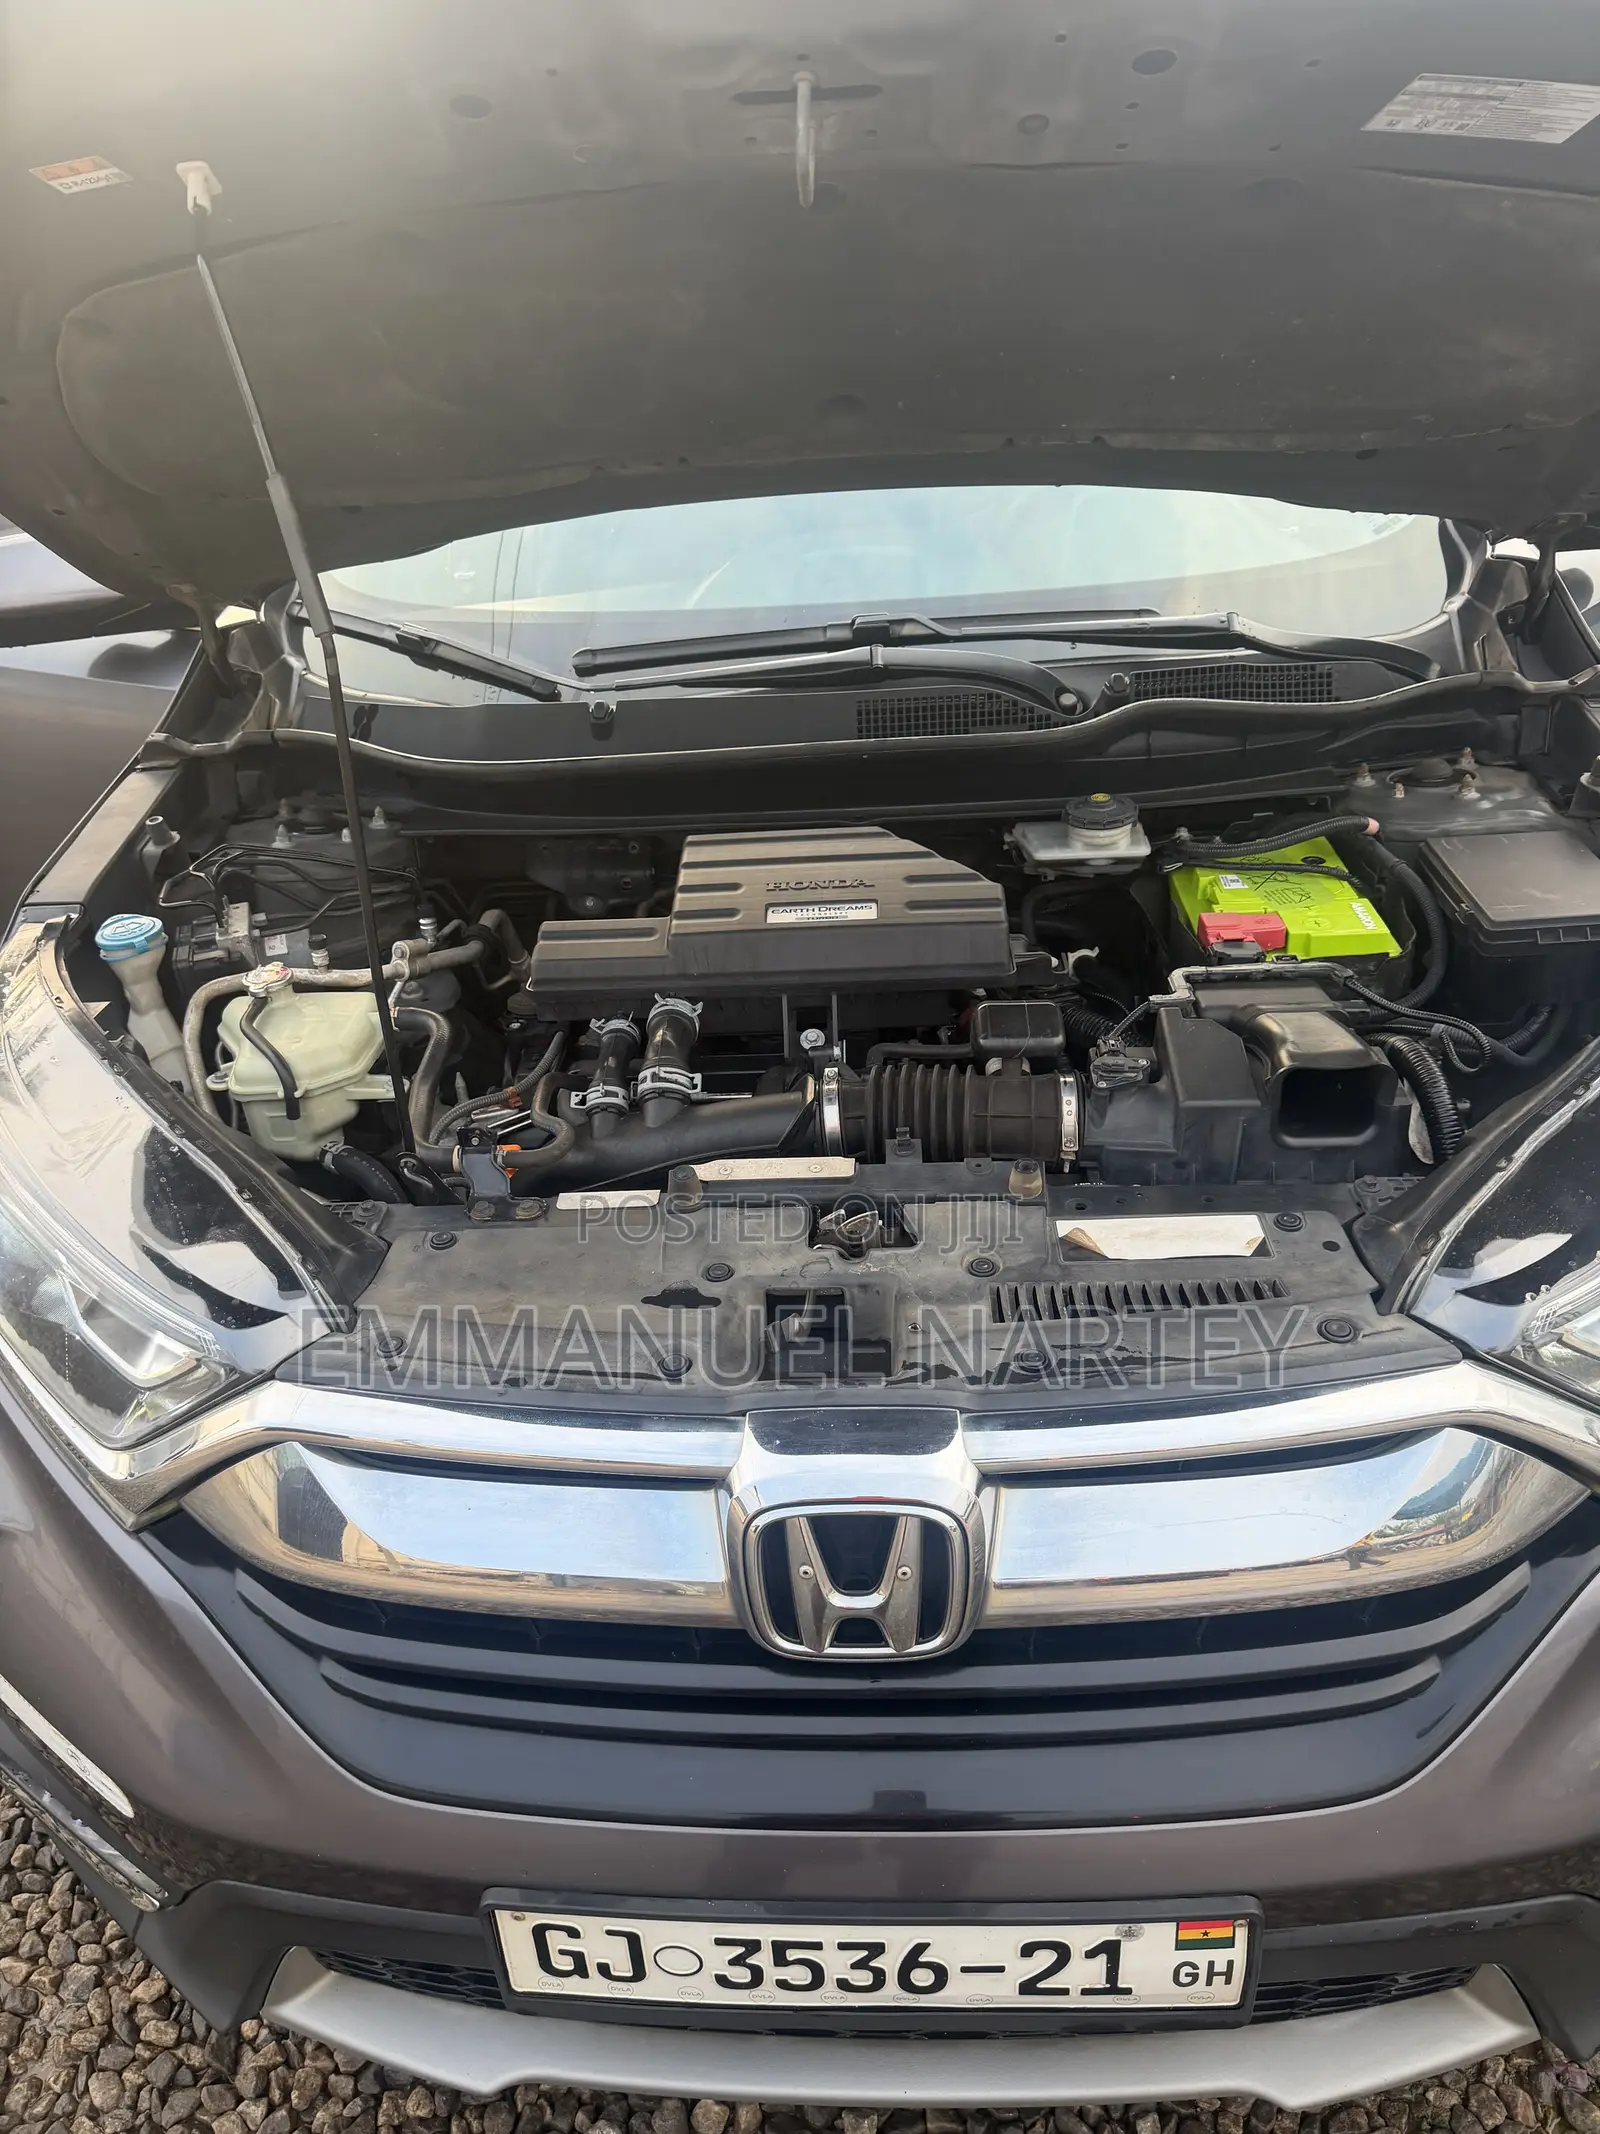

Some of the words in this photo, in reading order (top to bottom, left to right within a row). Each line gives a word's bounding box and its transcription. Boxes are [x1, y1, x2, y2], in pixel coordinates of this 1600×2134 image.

[765, 879, 875, 892] HONDA
[771, 907, 815, 915] EARTH
[818, 904, 873, 913] DREAMS
[1172, 1958, 1235, 1988] GH
